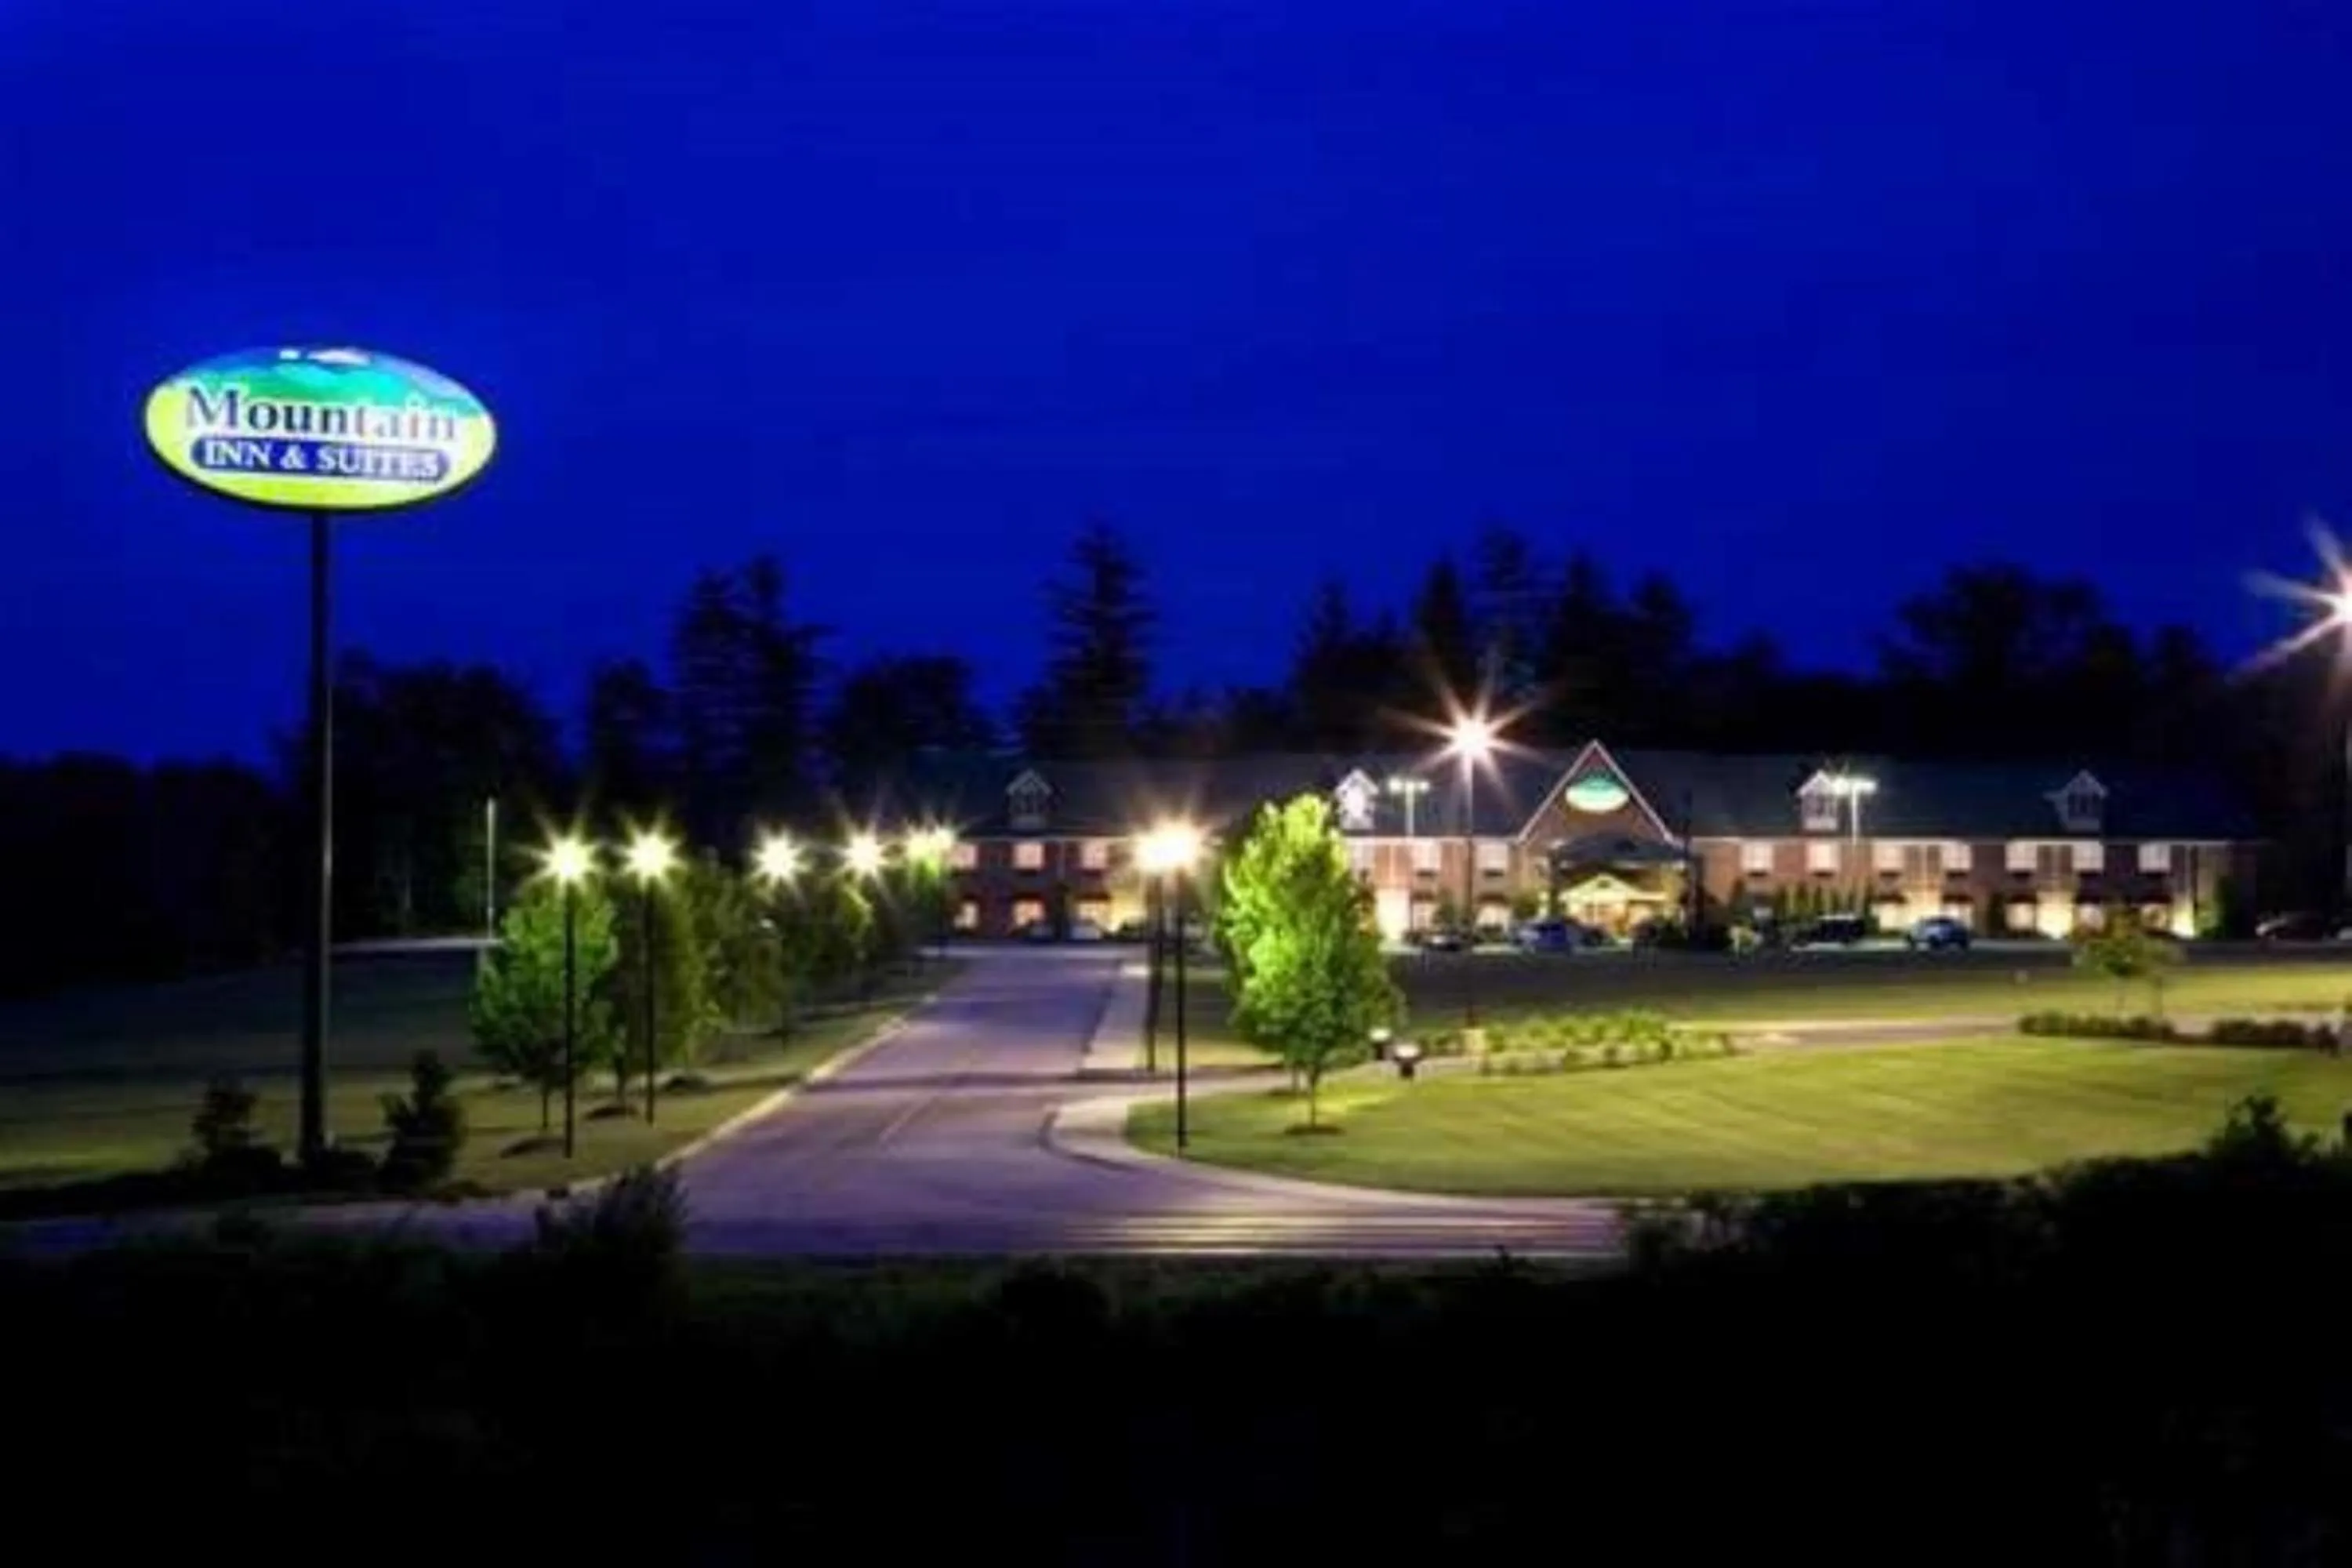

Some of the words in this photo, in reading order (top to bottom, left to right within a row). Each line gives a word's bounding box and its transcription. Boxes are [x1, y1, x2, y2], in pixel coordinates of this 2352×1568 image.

[187, 385, 456, 440] Mountain
[204, 440, 272, 467] INN
[279, 444, 306, 470] &
[316, 445, 439, 478] SUITES
